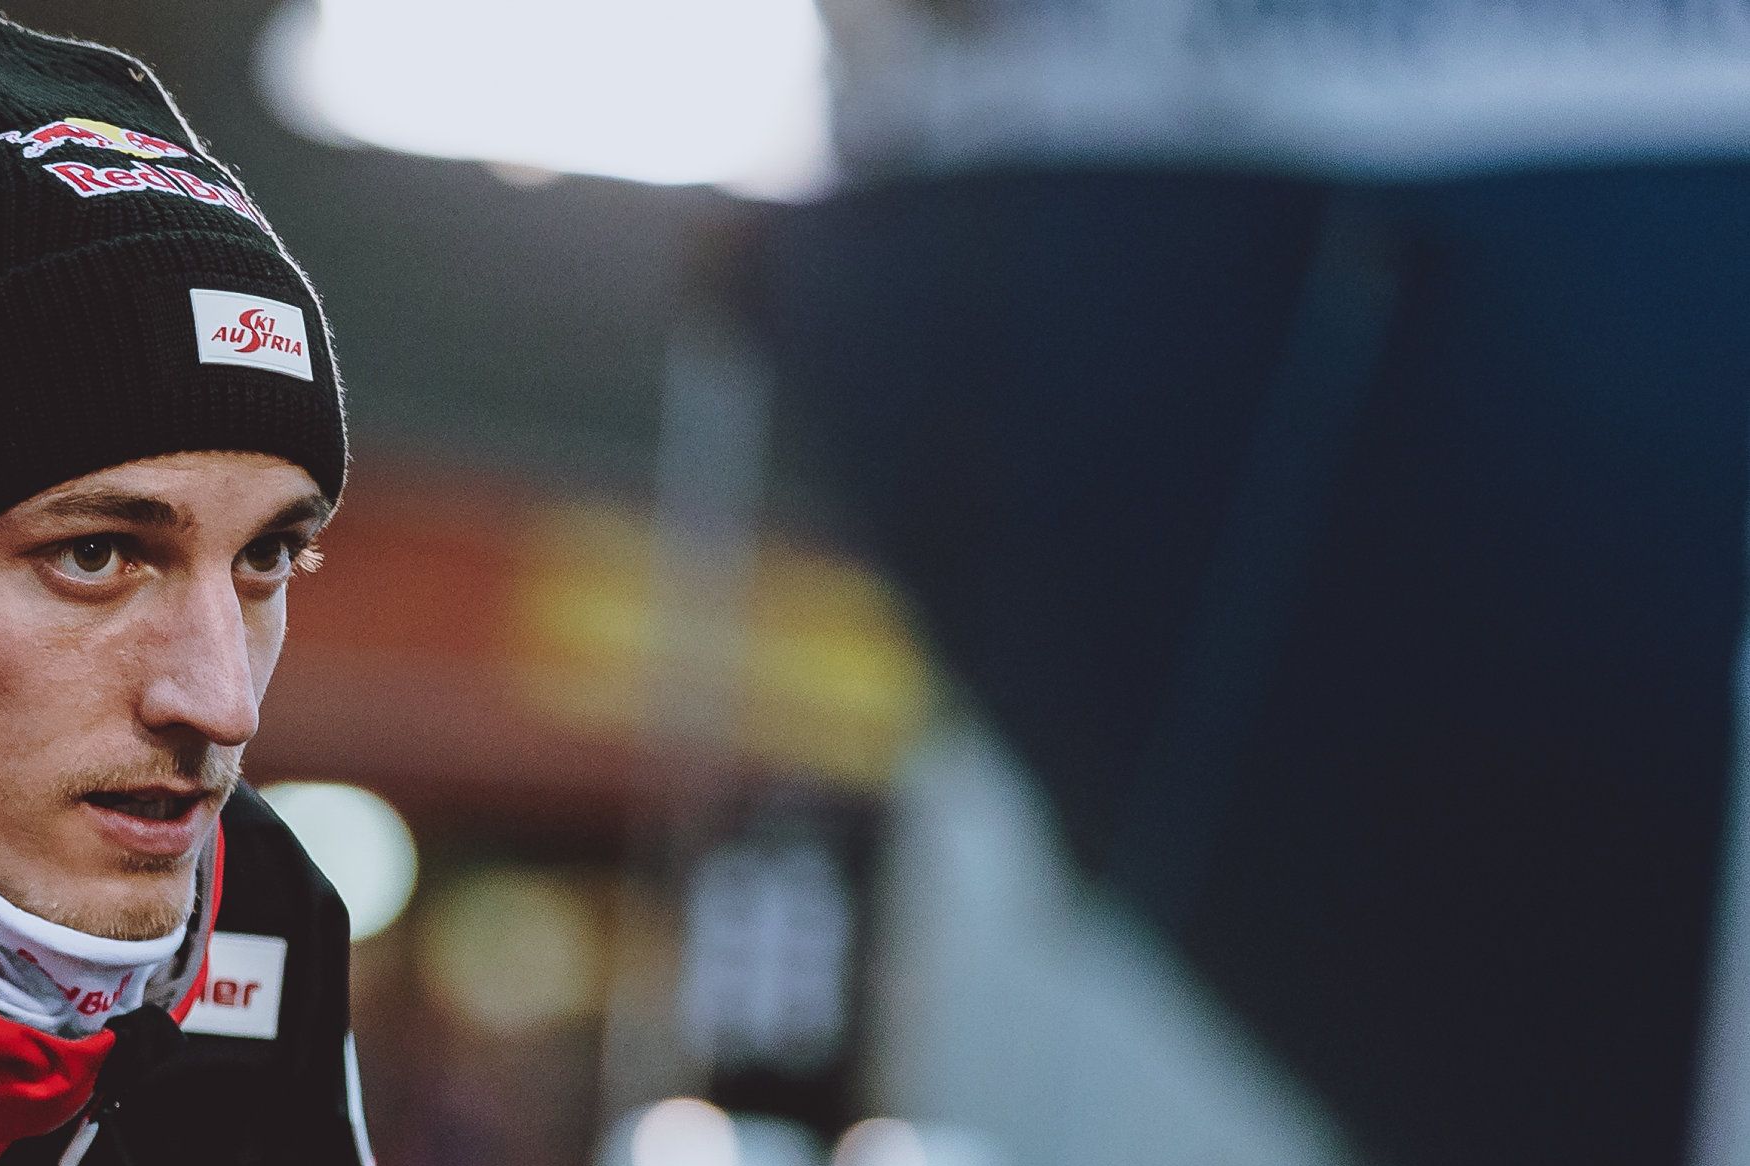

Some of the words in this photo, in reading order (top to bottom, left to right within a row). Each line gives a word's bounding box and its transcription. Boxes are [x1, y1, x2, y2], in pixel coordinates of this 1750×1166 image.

[42, 160, 188, 198] Red
[211, 324, 303, 357] AUSTRIA
[237, 308, 276, 340] SKI
